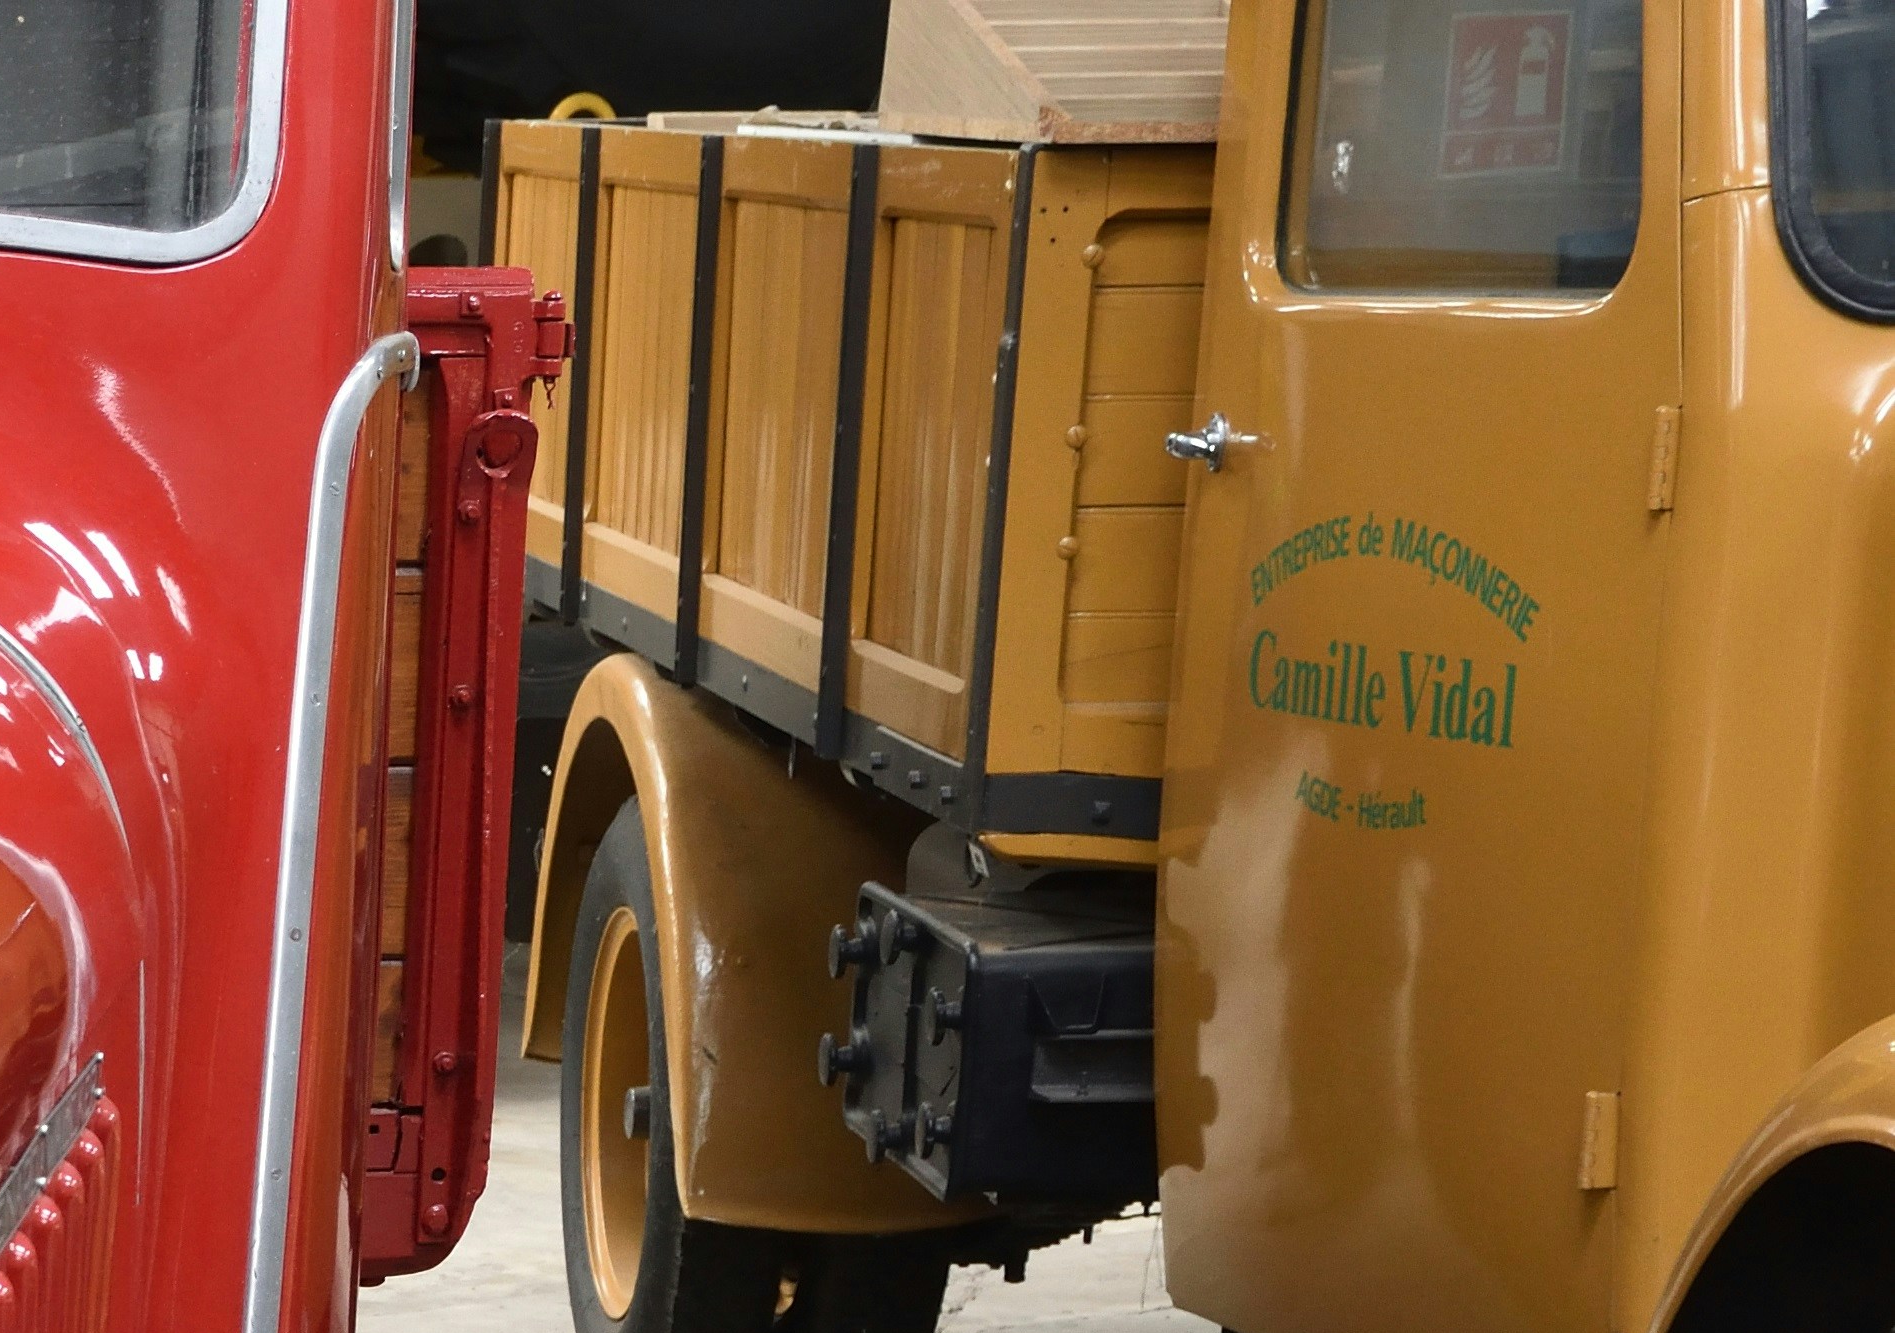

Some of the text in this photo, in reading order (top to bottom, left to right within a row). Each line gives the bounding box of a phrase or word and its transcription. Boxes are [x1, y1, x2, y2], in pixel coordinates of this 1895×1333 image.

[1251, 511, 1540, 643] ENTREPRISE de MAÇONNERIE
[1249, 629, 1517, 748] Camille Vidal
